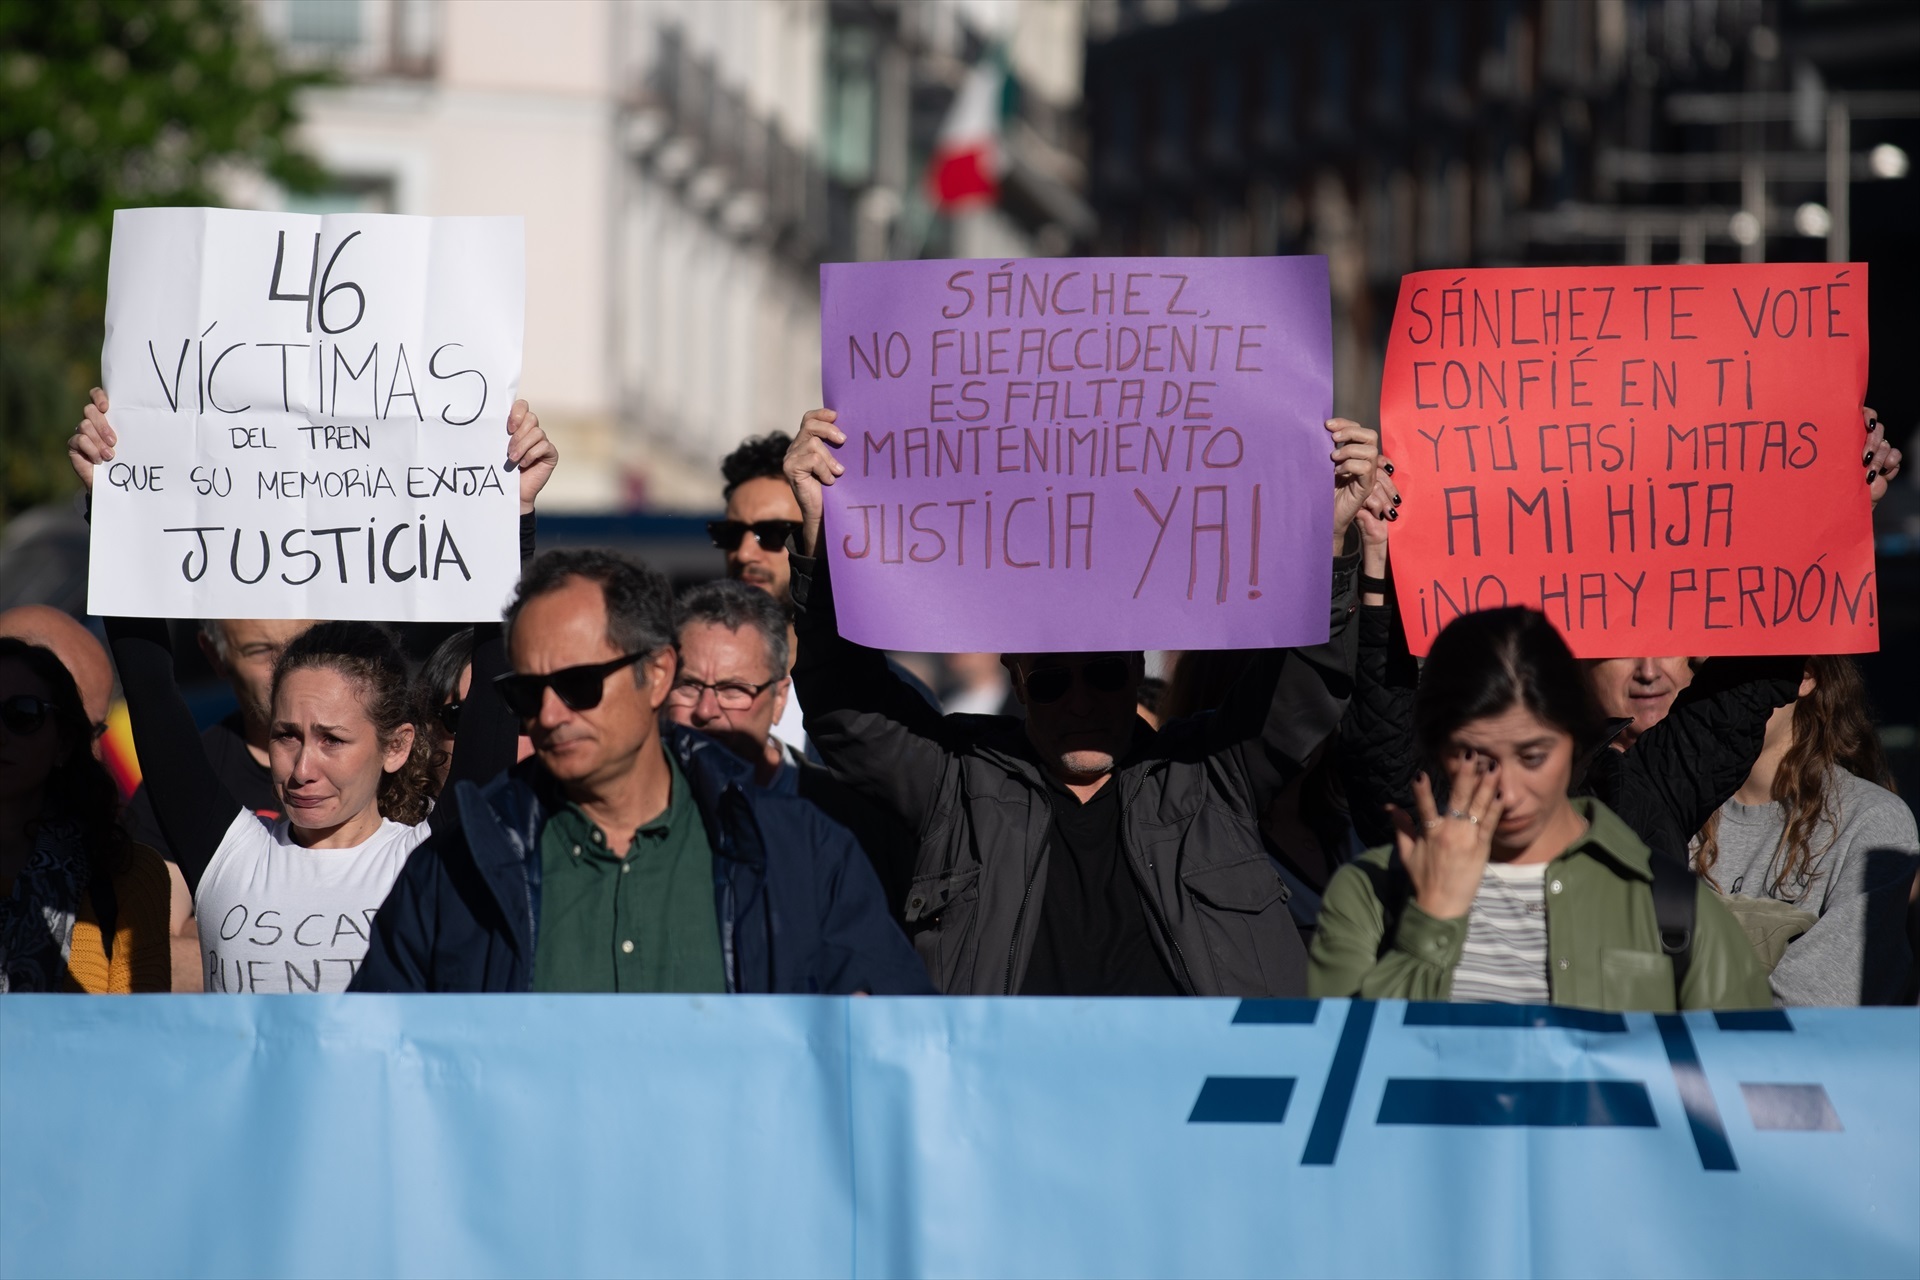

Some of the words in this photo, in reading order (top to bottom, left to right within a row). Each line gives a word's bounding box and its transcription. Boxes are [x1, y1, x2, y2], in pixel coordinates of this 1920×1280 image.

[269, 230, 365, 334] 46
[942, 262, 1210, 318] SÁNCHEZ,
[1408, 277, 1622, 348] SÁNCHEZ
[1633, 286, 1704, 341] TE
[1732, 270, 1850, 338] VOTÉ
[149, 321, 488, 426] VÍCTIMAS
[849, 332, 911, 379] NO
[1413, 346, 1598, 410] CONFIÉ
[1620, 358, 1677, 410] EN
[1706, 350, 1754, 410] TI
[931, 381, 990, 422] ES
[1005, 378, 1146, 422] FALTA
[1156, 382, 1220, 419] DE
[229, 427, 277, 449] DEL
[298, 425, 370, 450] TREN
[863, 422, 1244, 479] MANTENIMIENTO
[1538, 418, 1636, 473] CASI
[1666, 421, 1818, 472] MATAS
[108, 462, 164, 492] QUE
[189, 466, 232, 497] SU
[258, 464, 396, 499] MEMORIA
[843, 487, 1095, 569] JUSTICIA
[1133, 484, 1262, 605] YA!
[1443, 485, 1481, 556] A
[1507, 480, 1574, 555] MI
[1606, 477, 1734, 554] HIJA
[163, 514, 472, 585] JUSTICIA
[1540, 571, 1646, 631] HAY
[1669, 554, 1878, 631] PERDÓN!
